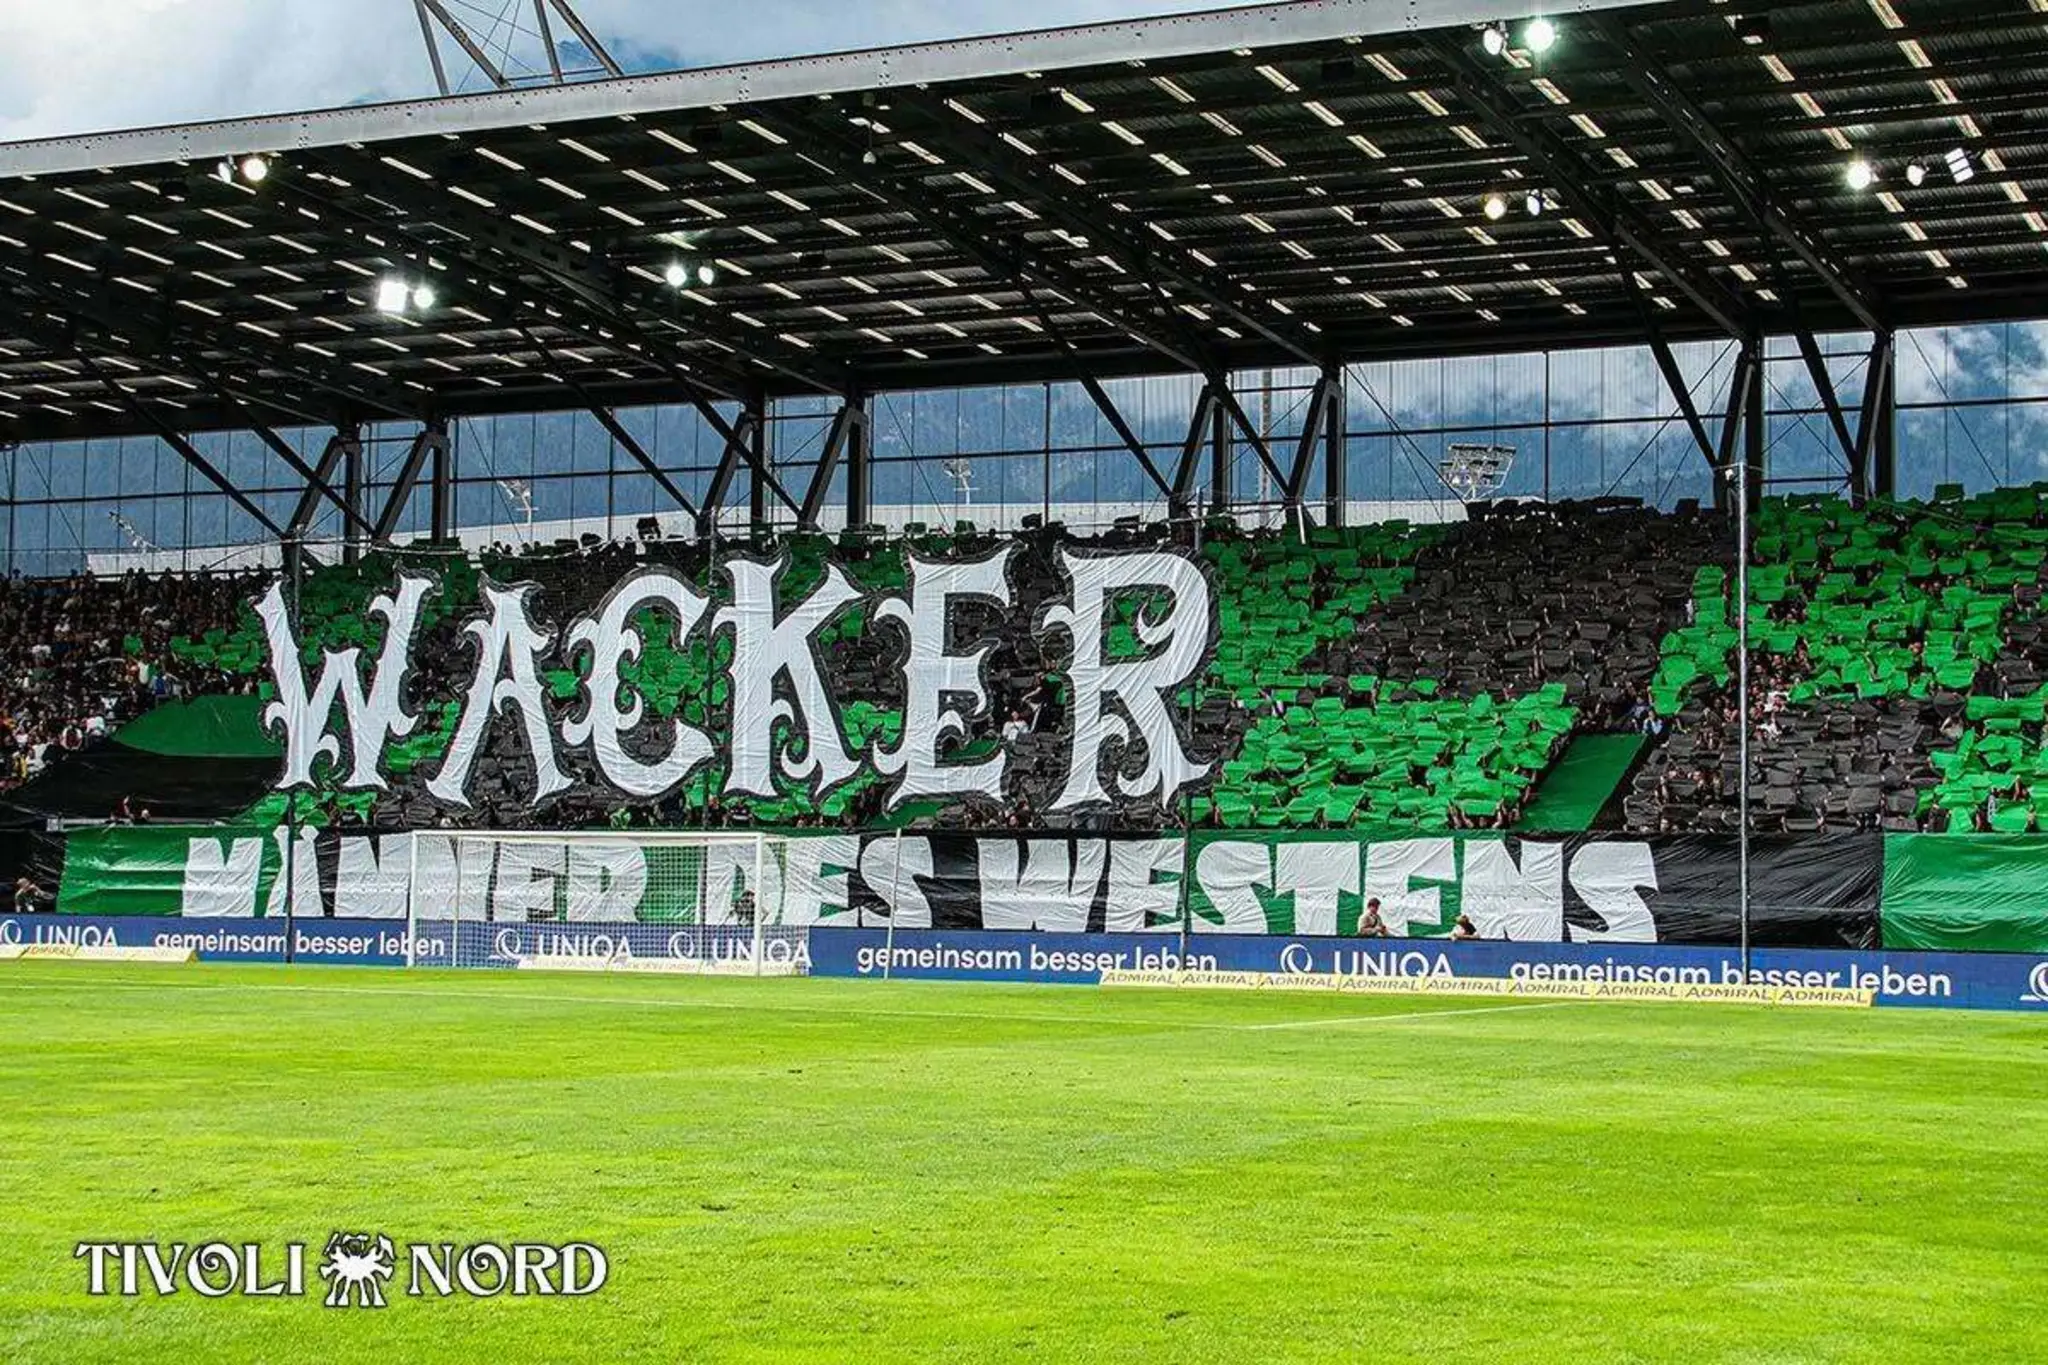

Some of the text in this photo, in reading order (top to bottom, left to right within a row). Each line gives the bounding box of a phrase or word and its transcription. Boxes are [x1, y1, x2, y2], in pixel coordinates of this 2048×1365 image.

[256, 547, 1213, 812] WACKER
[182, 825, 1660, 942] MÄNNER DES WESTENS
[36, 925, 119, 947] UNIQA
[155, 928, 287, 955] gemeinsam
[295, 930, 373, 956] besser
[379, 931, 445, 957] leben
[538, 934, 634, 963] UNIQA
[713, 938, 813, 968] UNIQA
[857, 943, 1217, 974] gemeinsam besser leben
[1334, 950, 1454, 977] UNIQA
[1103, 972, 1868, 1003] ADMIRAL ADMIRAL ADMIRAL ADMIRAL ADMIRAL ADMIRAL ADMIRAL ADMIRAL ADMIRAL
[1510, 957, 1951, 996] gemeinsam besser leben
